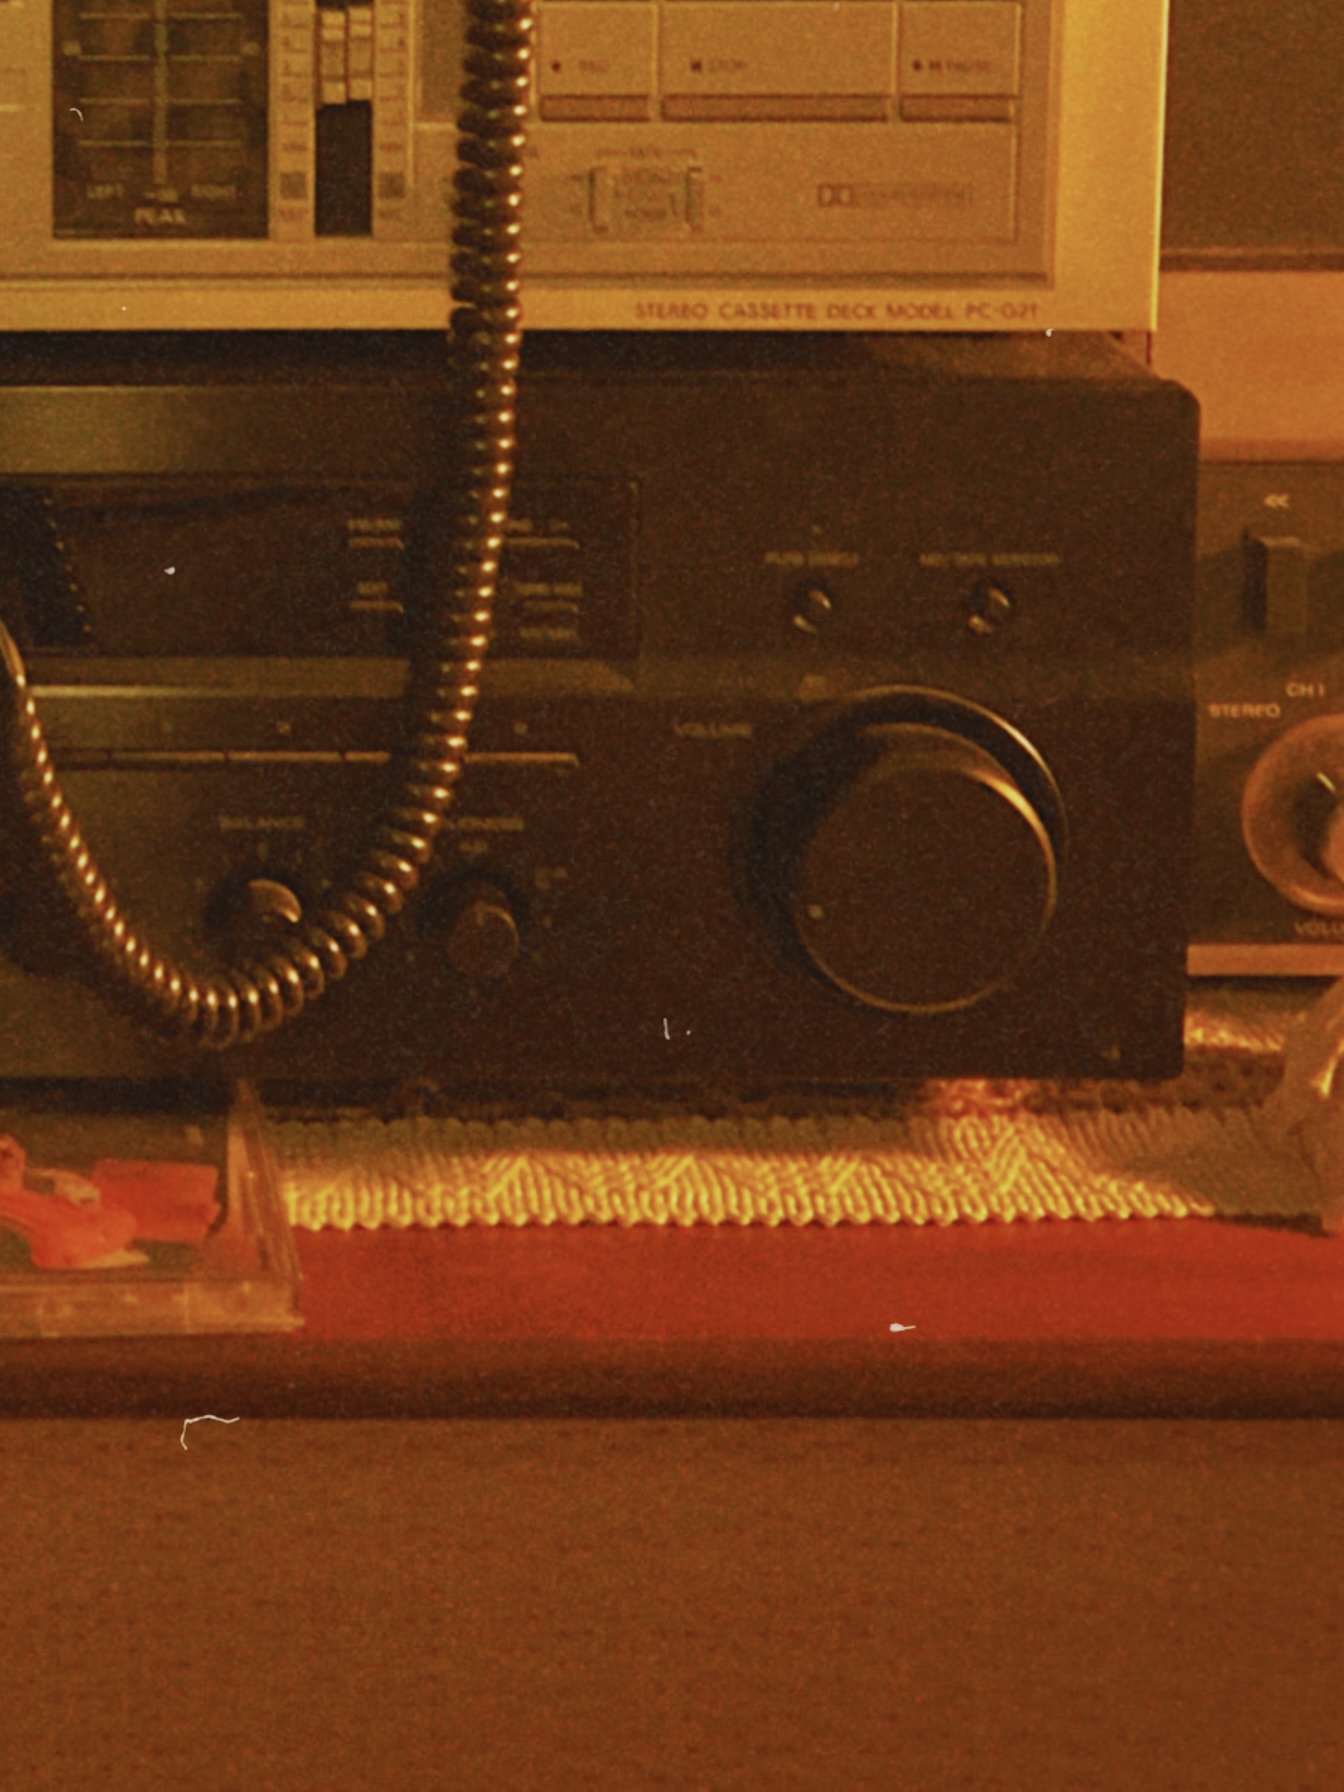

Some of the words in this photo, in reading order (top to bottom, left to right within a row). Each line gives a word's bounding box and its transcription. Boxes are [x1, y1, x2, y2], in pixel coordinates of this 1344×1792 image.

[634, 302, 709, 321] STEREO
[718, 302, 817, 321] CASSETTE
[825, 302, 876, 321] DECK
[885, 302, 955, 321] MODEL
[1285, 682, 1314, 697] CH
[1208, 702, 1282, 719] STEREO
